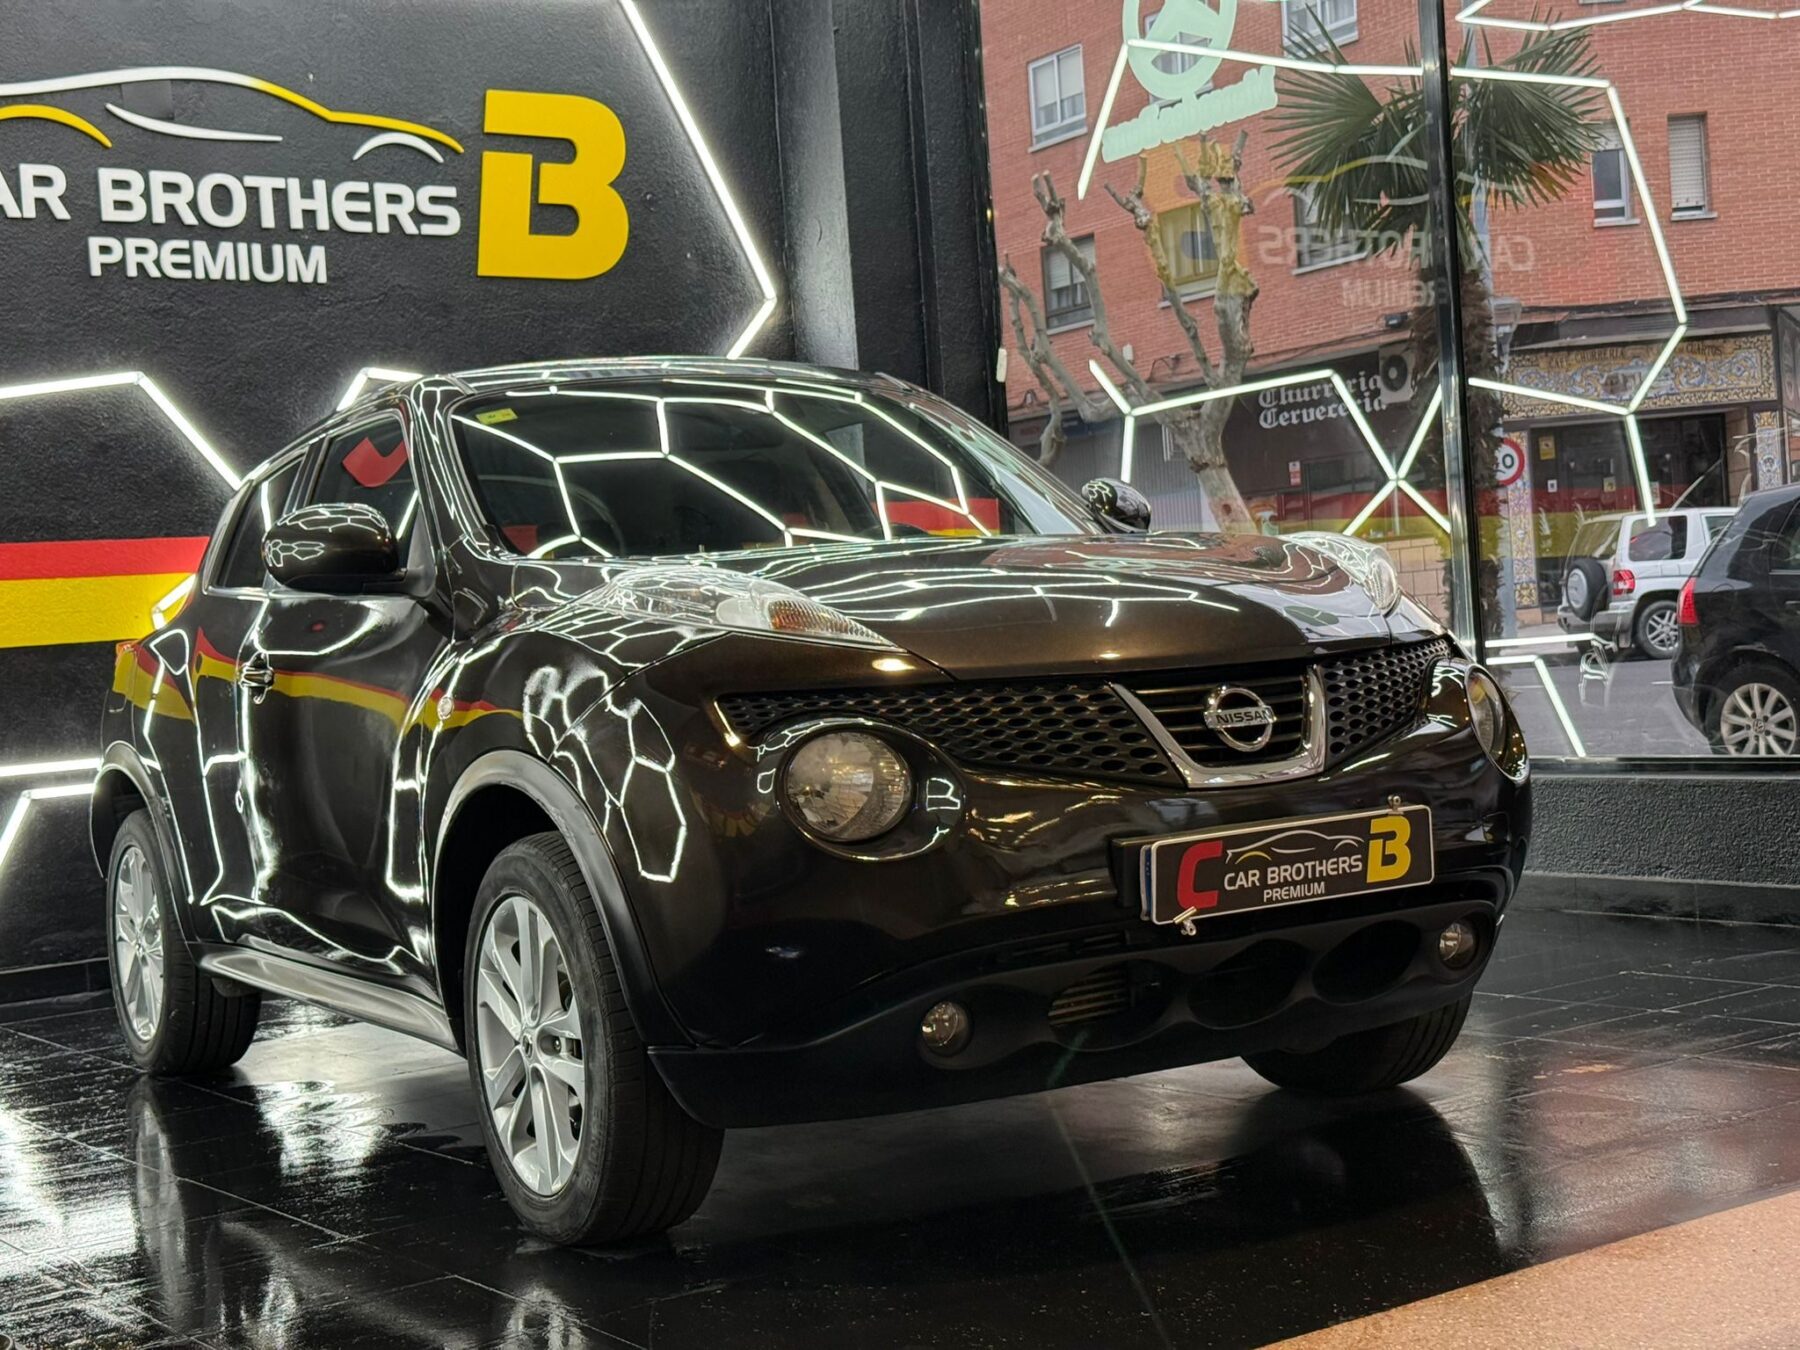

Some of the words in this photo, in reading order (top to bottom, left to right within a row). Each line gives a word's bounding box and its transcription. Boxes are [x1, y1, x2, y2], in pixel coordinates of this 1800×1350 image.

[98, 167, 461, 236] BROTHERS
[88, 236, 328, 284] PREMIUM
[1258, 371, 1382, 408] Churrria
[1259, 392, 1388, 429] Cerveceia
[1216, 709, 1272, 726] NISSAN
[1223, 869, 1260, 891] CAR
[1266, 854, 1363, 886] BROTHERS
[1263, 881, 1326, 903] PREMIUM
